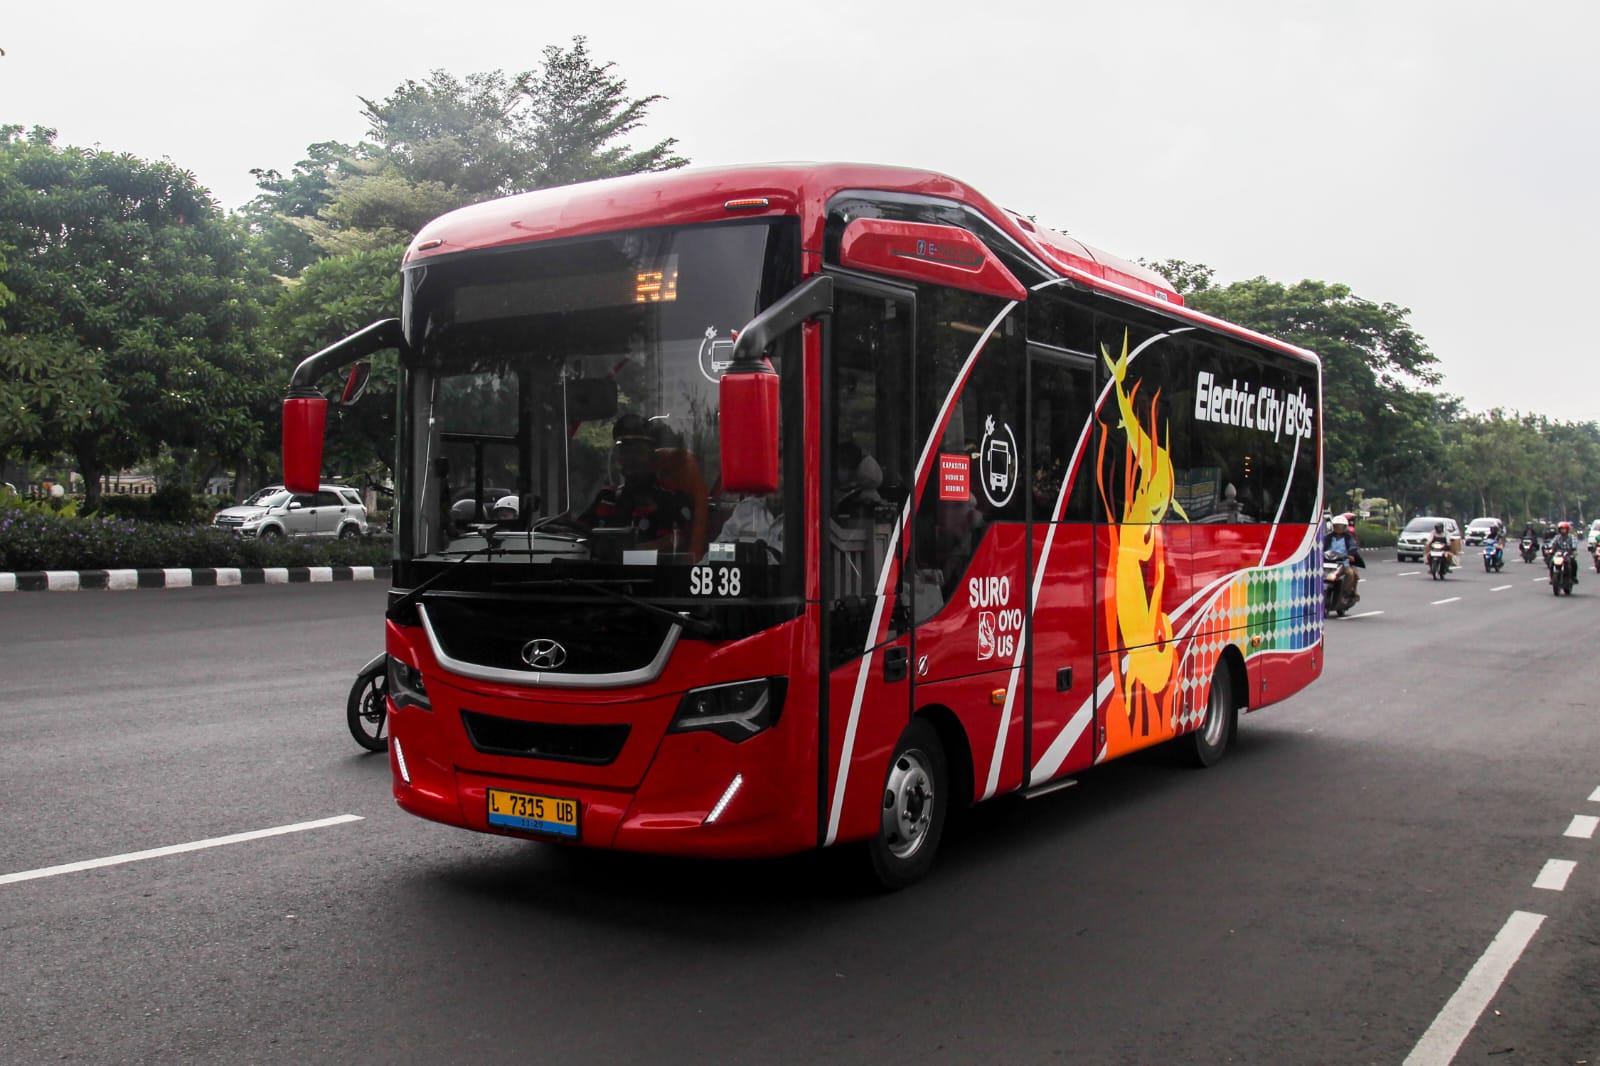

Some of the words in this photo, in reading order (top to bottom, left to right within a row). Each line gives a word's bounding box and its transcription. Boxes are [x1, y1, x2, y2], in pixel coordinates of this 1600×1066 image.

[1194, 370, 1256, 429] Electric
[1257, 386, 1285, 443] City
[690, 566, 713, 595] SB
[718, 566, 741, 596] 38
[969, 575, 1010, 609] SURO
[491, 793, 499, 812] L
[510, 795, 544, 818] 7315
[556, 802, 574, 822] UB
